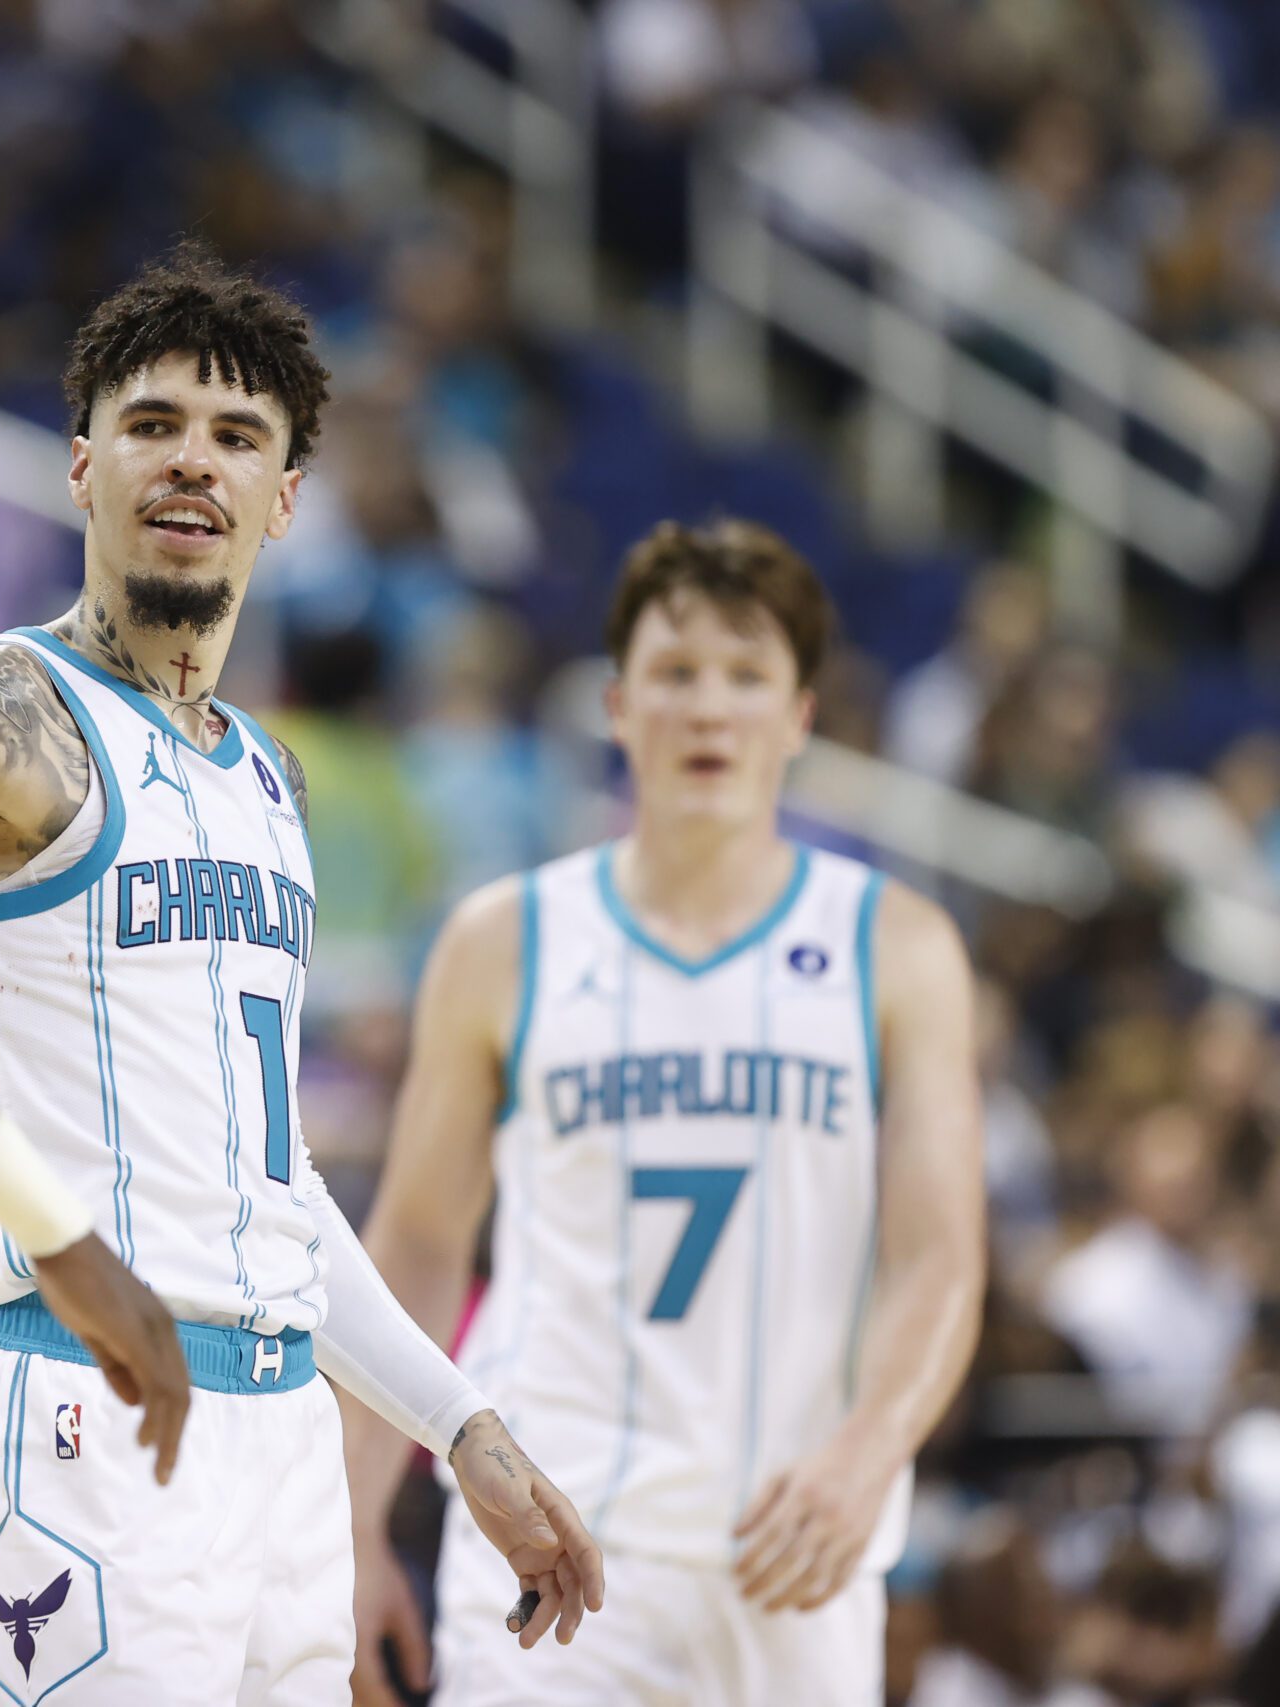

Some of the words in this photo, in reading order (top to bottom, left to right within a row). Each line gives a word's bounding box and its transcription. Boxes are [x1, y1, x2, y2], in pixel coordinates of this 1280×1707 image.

[239, 991, 290, 1186] 1
[545, 1050, 850, 1137] CHARLOTTE
[630, 1167, 751, 1322] 7
[58, 1446, 72, 1457] NBA
